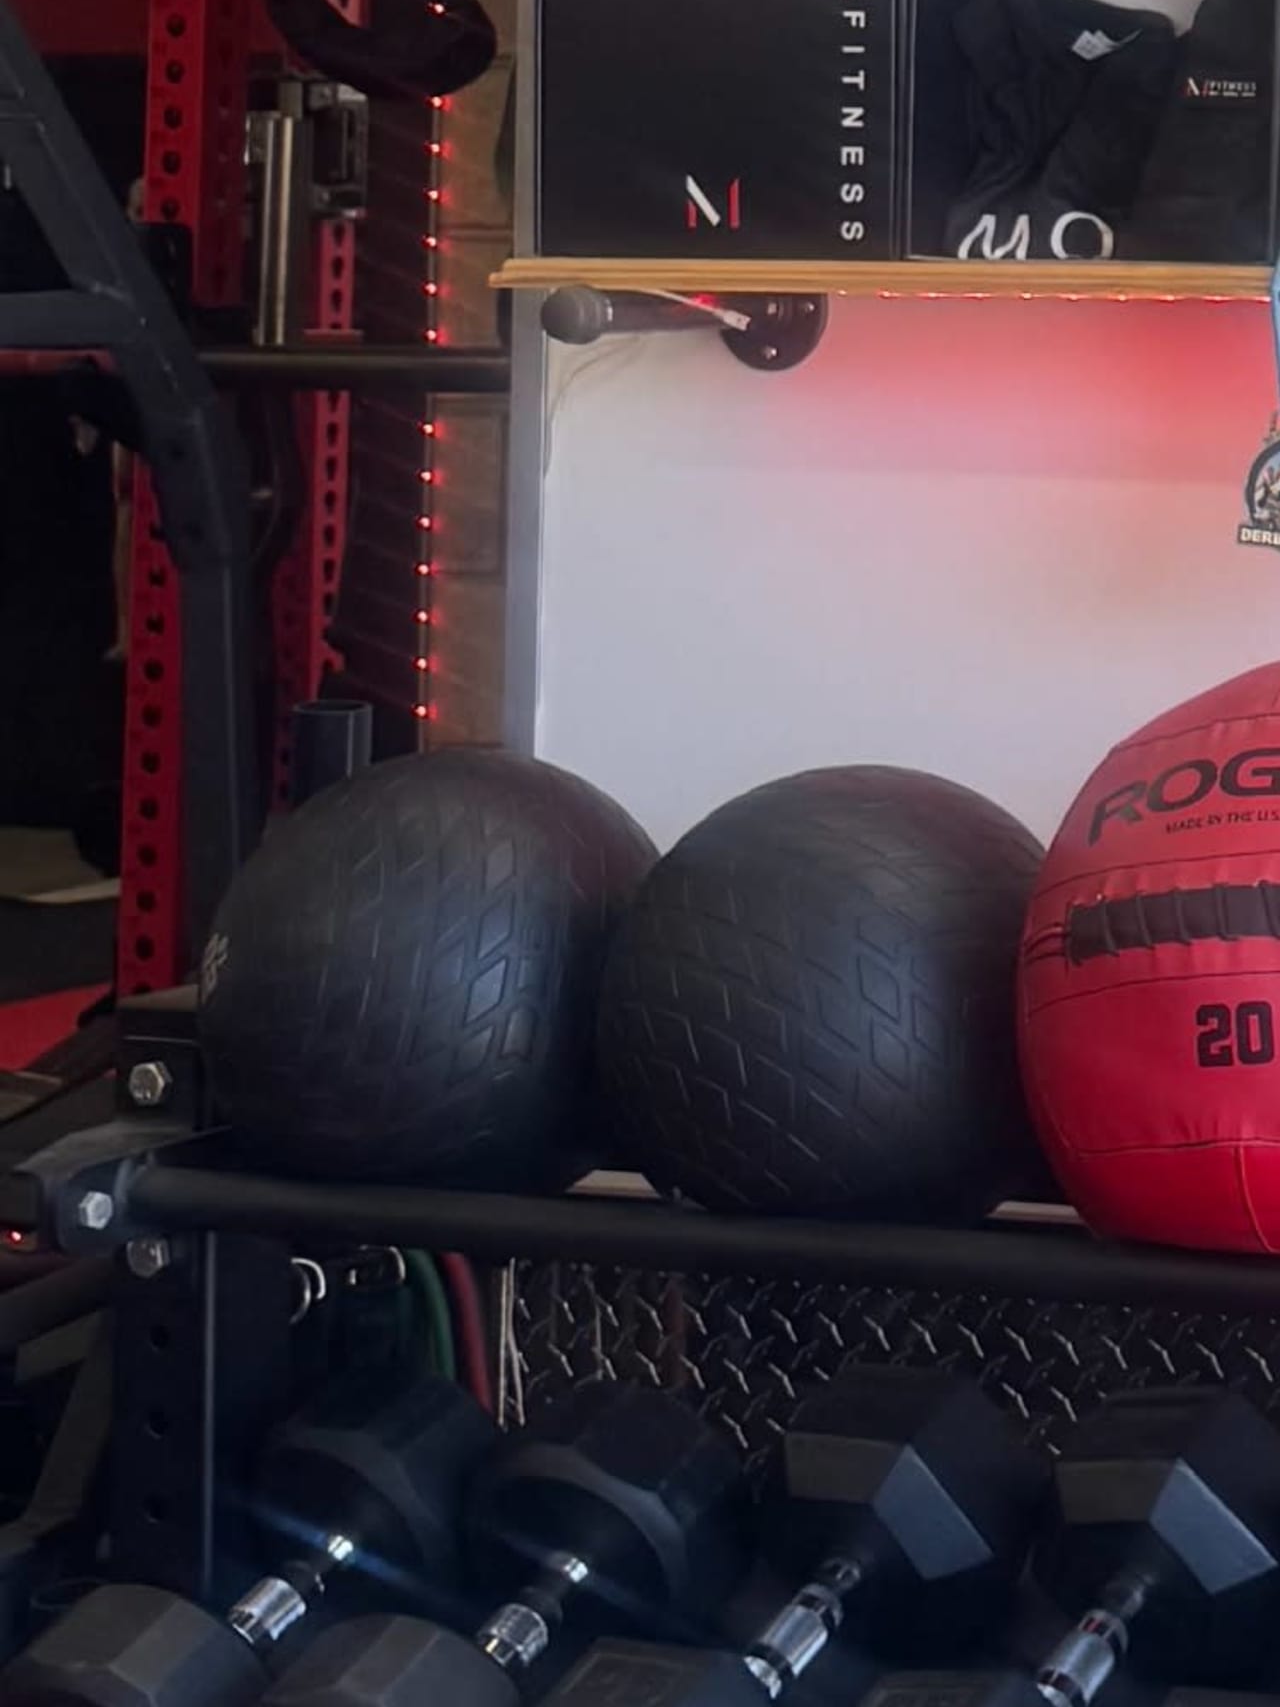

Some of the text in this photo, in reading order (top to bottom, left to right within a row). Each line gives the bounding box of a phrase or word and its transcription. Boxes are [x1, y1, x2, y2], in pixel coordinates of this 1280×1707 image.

[839, 11, 866, 242] FITNESS
[1166, 818, 1201, 833] MADE
[1208, 814, 1221, 825] IN
[1228, 810, 1251, 824] THE
[1196, 1001, 1275, 1068] 20
